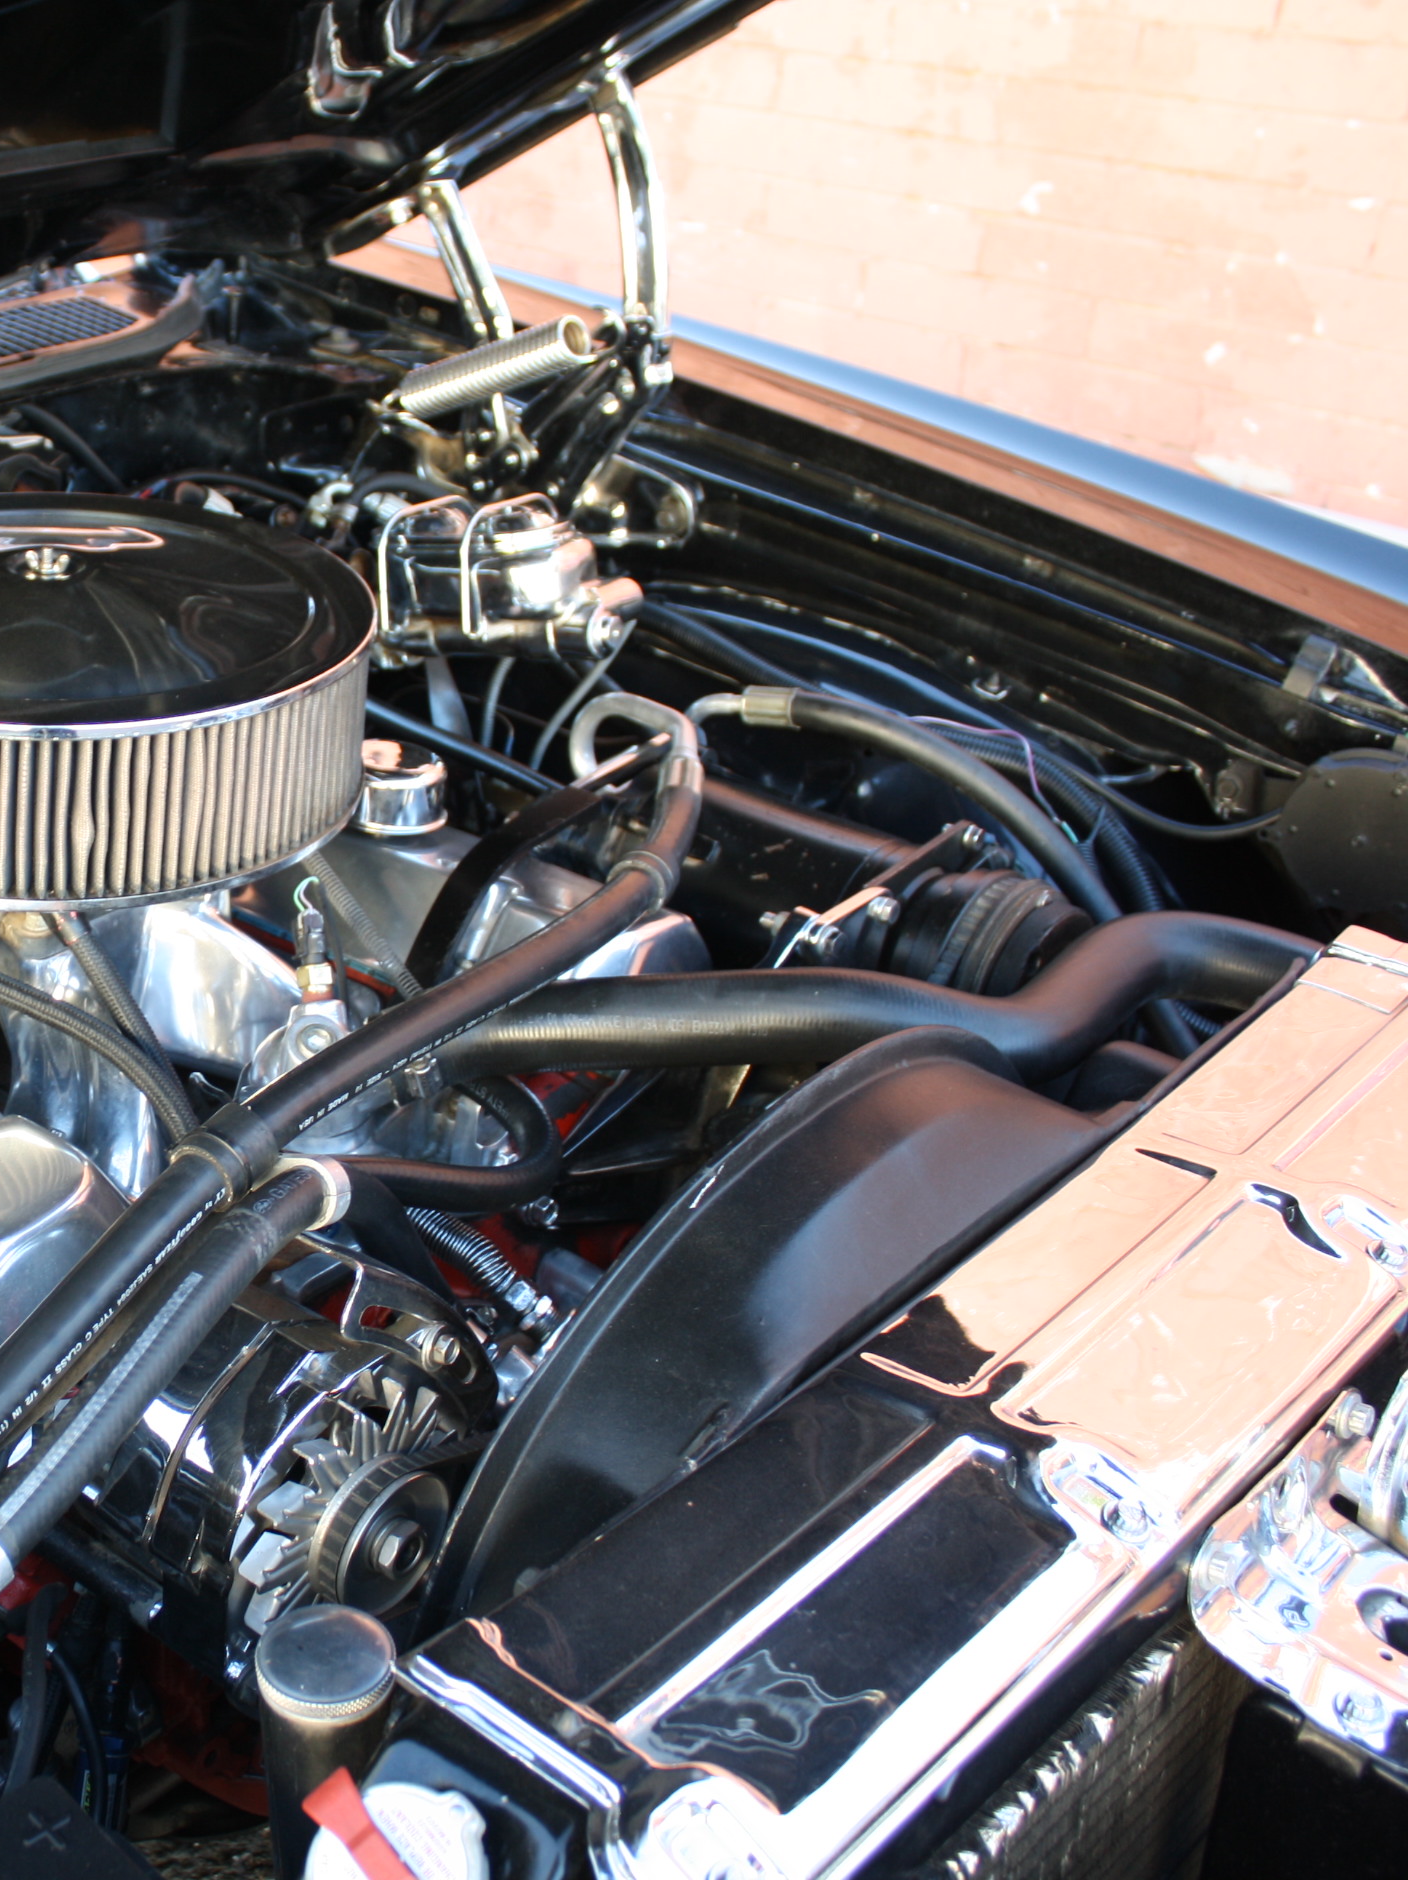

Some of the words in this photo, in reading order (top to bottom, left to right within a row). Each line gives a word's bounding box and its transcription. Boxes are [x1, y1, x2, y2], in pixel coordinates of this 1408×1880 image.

[327, 1092, 350, 1112] MADE
[298, 1117, 314, 1132] USA
[92, 1307, 114, 1332] TYPE
[54, 1342, 83, 1375] CLASS
[24, 1389, 39, 1406] 1/2
[11, 1405, 23, 1420] IN
